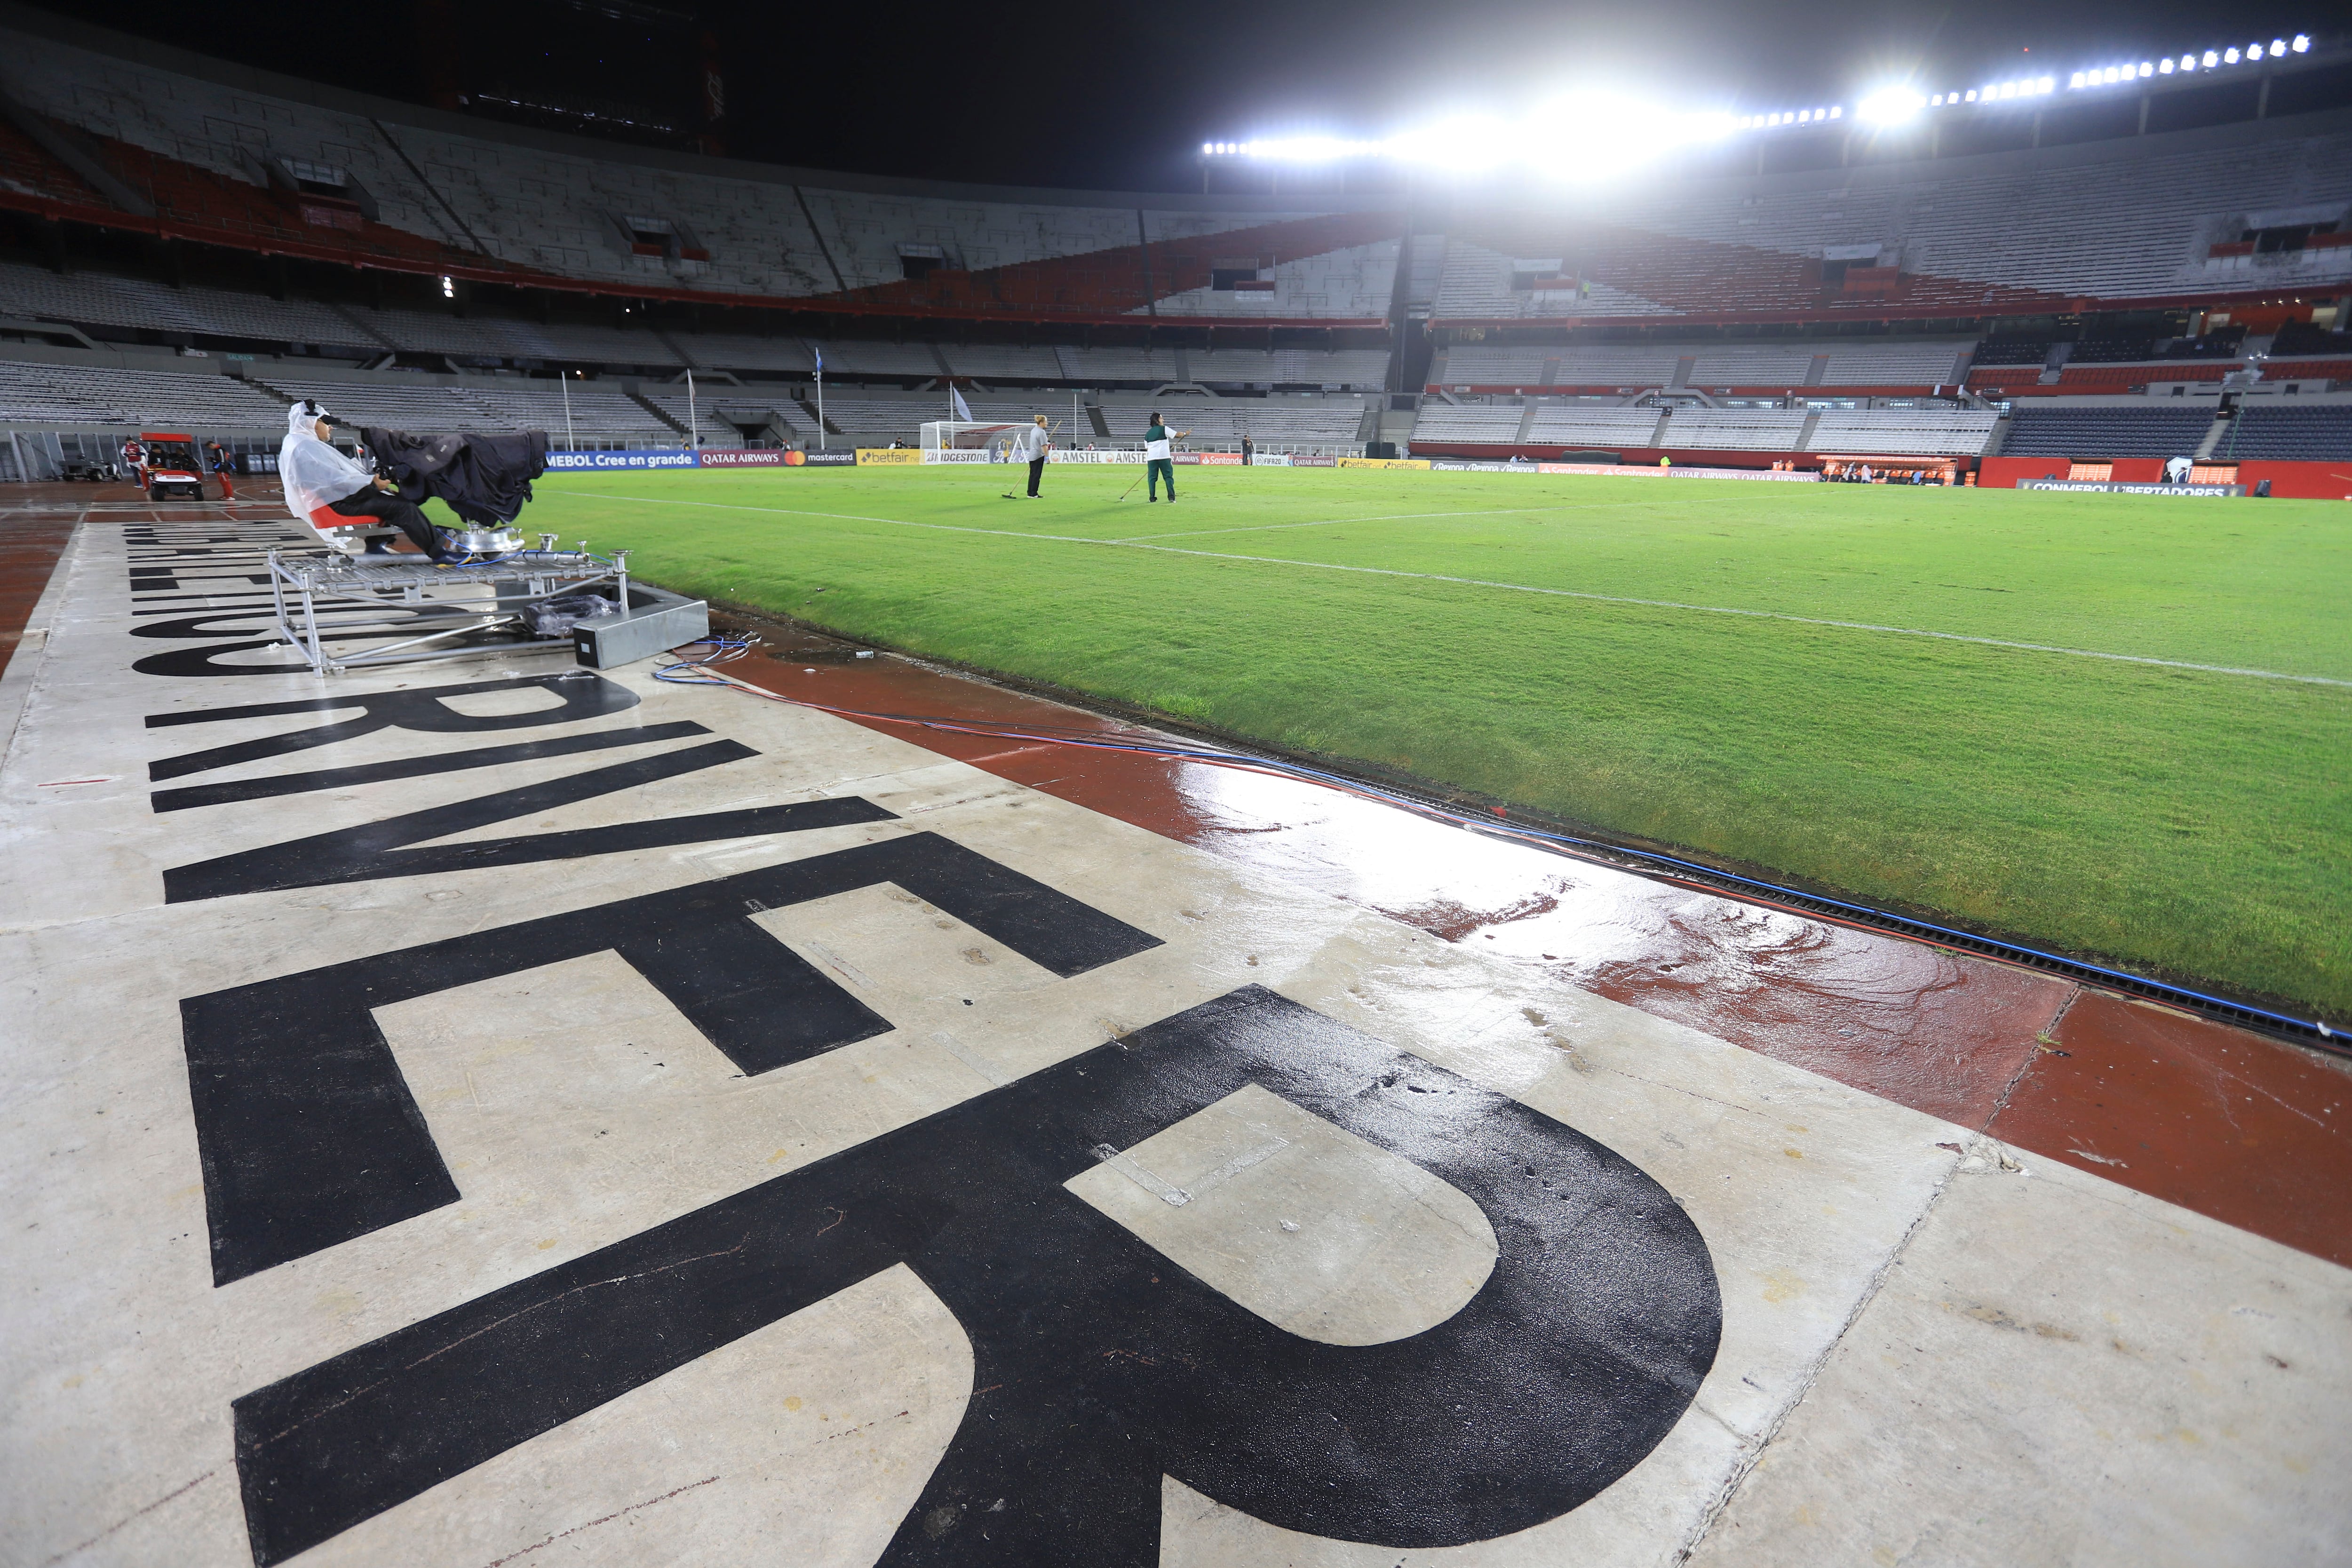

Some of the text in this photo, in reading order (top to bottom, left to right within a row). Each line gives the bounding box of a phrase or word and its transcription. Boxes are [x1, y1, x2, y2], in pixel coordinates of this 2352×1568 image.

[595, 454, 626, 466] Cree
[628, 457, 645, 466] en
[647, 454, 696, 468] grande.
[702, 453, 779, 465] QATAR AIRWAYS
[808, 453, 853, 462] mastercard
[1062, 453, 1101, 463] AMSTEL
[1116, 453, 1148, 463] AMSTE
[1210, 456, 1243, 465] Santande
[1471, 463, 1499, 472] Rexona
[1506, 464, 1535, 473] Rexona
[1551, 466, 1665, 477] Santander Santander
[1700, 471, 1738, 480] AIRWAYS
[144, 671, 1722, 1568] RIVER
